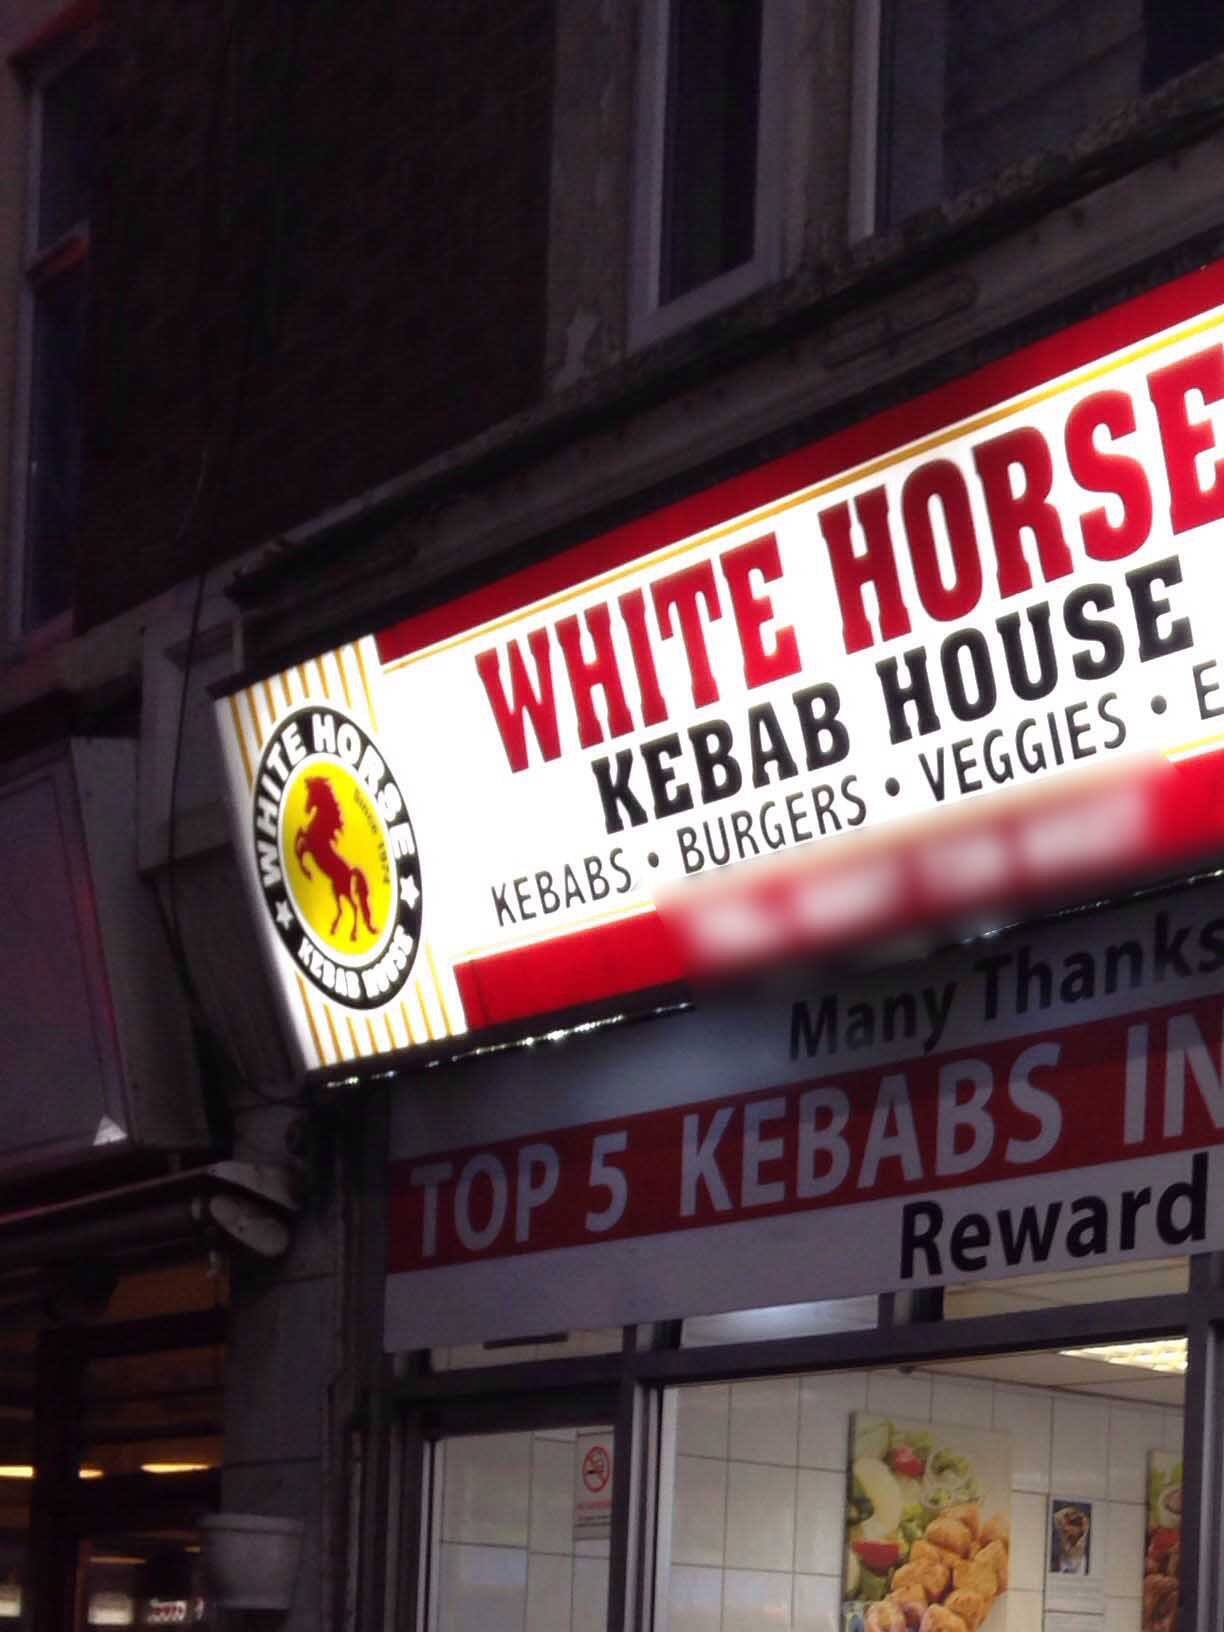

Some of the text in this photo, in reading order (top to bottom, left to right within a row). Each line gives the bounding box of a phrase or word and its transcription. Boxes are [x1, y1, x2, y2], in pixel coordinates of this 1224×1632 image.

[475, 532, 803, 773] WHITE
[590, 555, 1194, 835] KEBAB HOUSE
[259, 713, 416, 889] WHITE HORSE
[491, 846, 633, 927] KEBABS
[678, 774, 868, 873] BURGERS
[919, 692, 1128, 801] VEGGIES
[789, 979, 957, 1060] Many
[409, 1142, 561, 1260] TOP
[586, 1132, 630, 1231] 5
[679, 1042, 1063, 1217] KEBABS
[899, 1152, 1209, 1280] Reward
